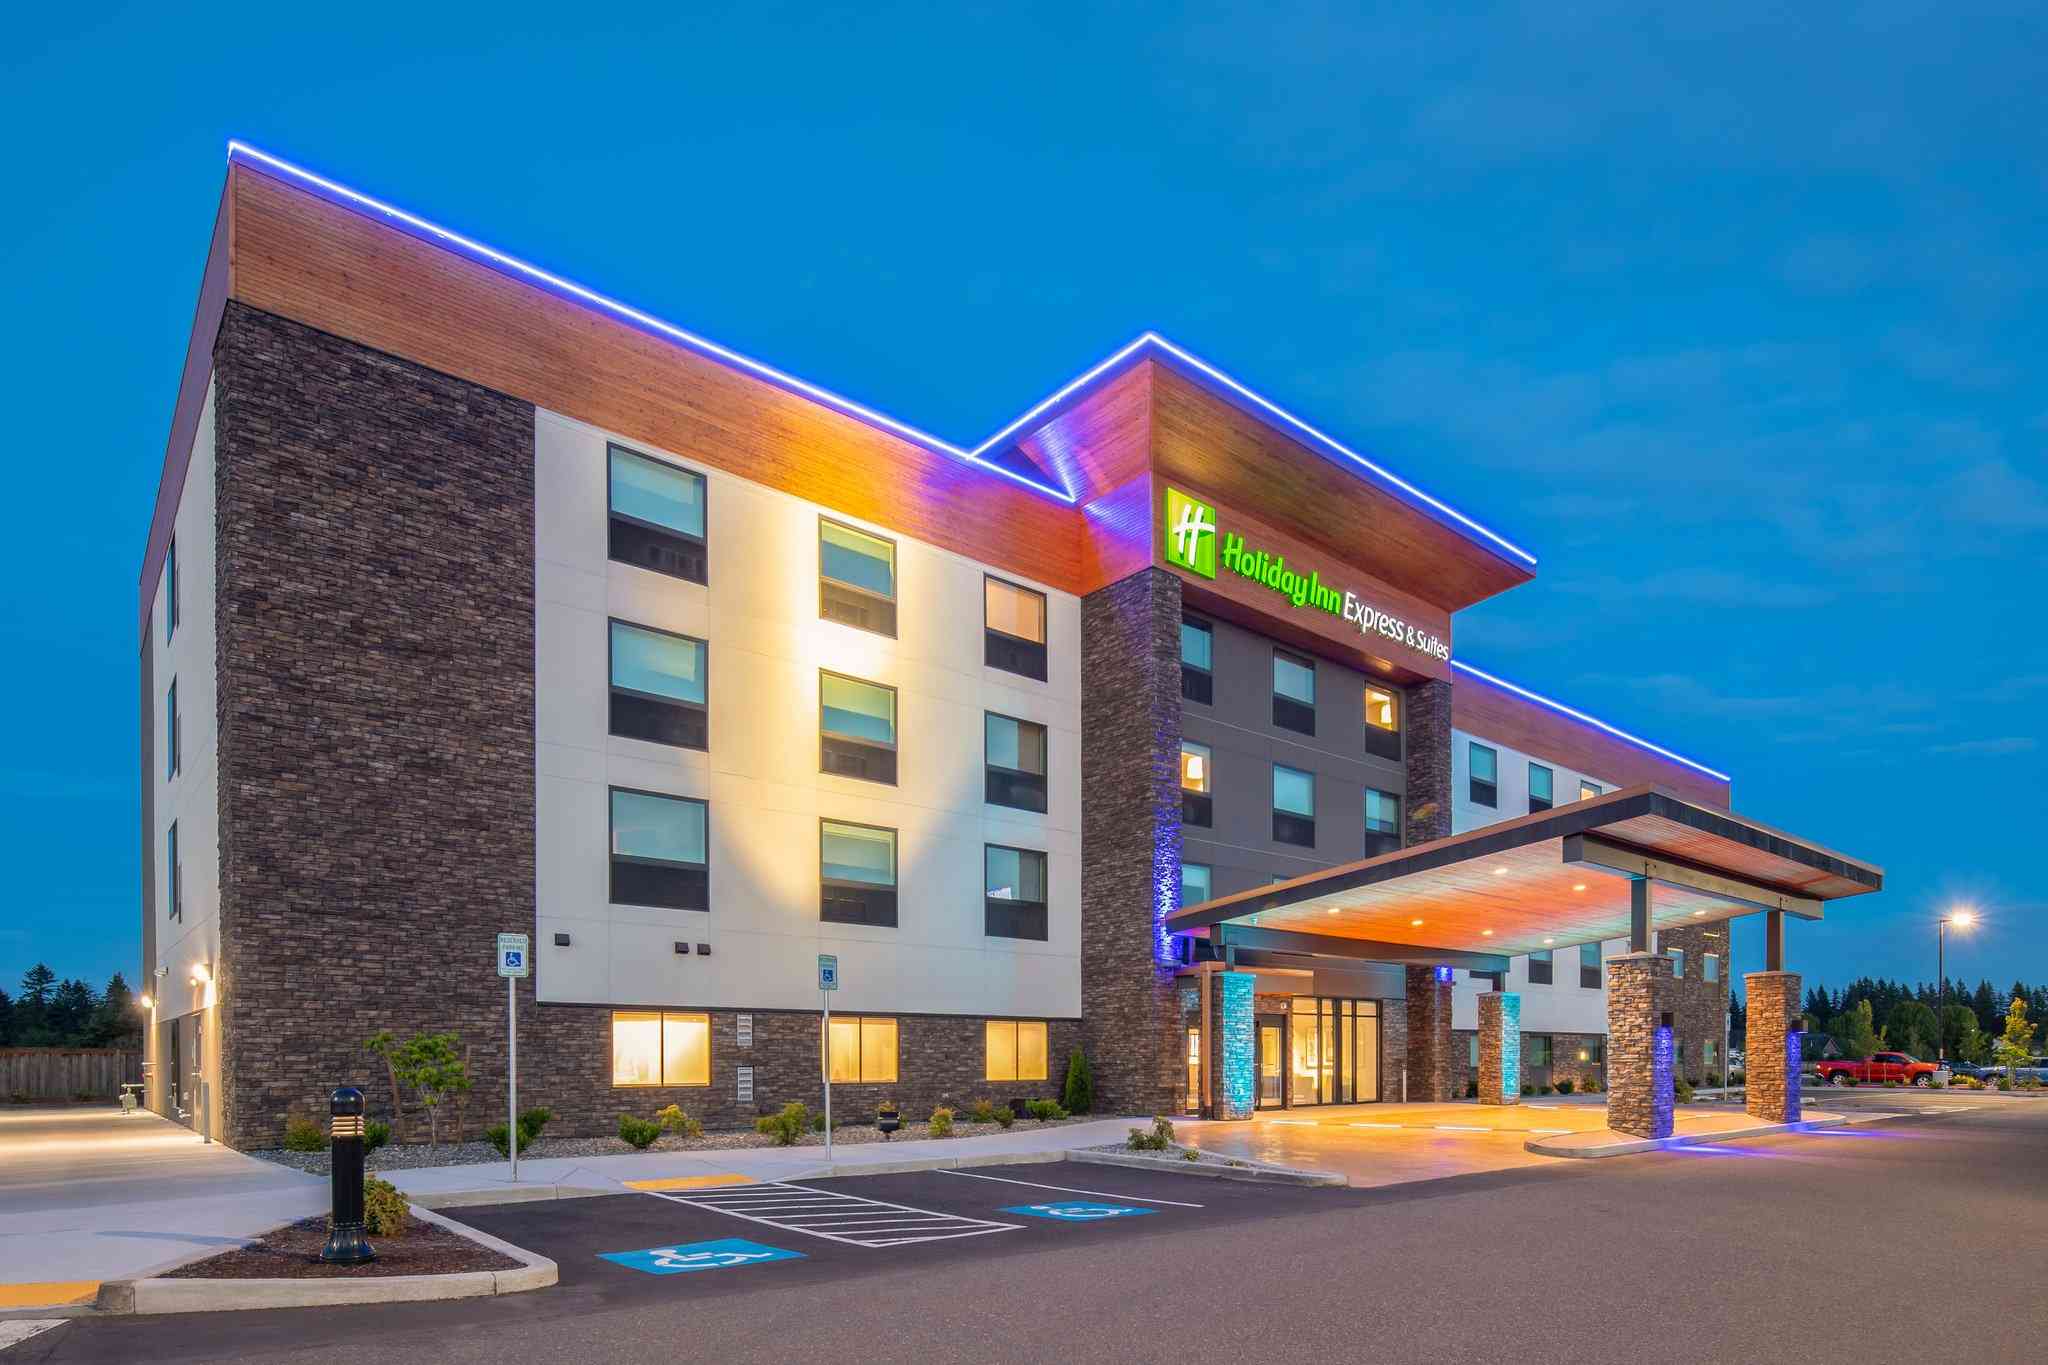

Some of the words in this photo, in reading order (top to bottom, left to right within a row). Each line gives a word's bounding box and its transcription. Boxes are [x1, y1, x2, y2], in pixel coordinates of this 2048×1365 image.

[1222, 532, 1307, 607] Holiday
[1309, 571, 1341, 615] Inn
[1343, 591, 1405, 641] Express
[1406, 625, 1415, 647] &
[1416, 630, 1449, 661] Suites
